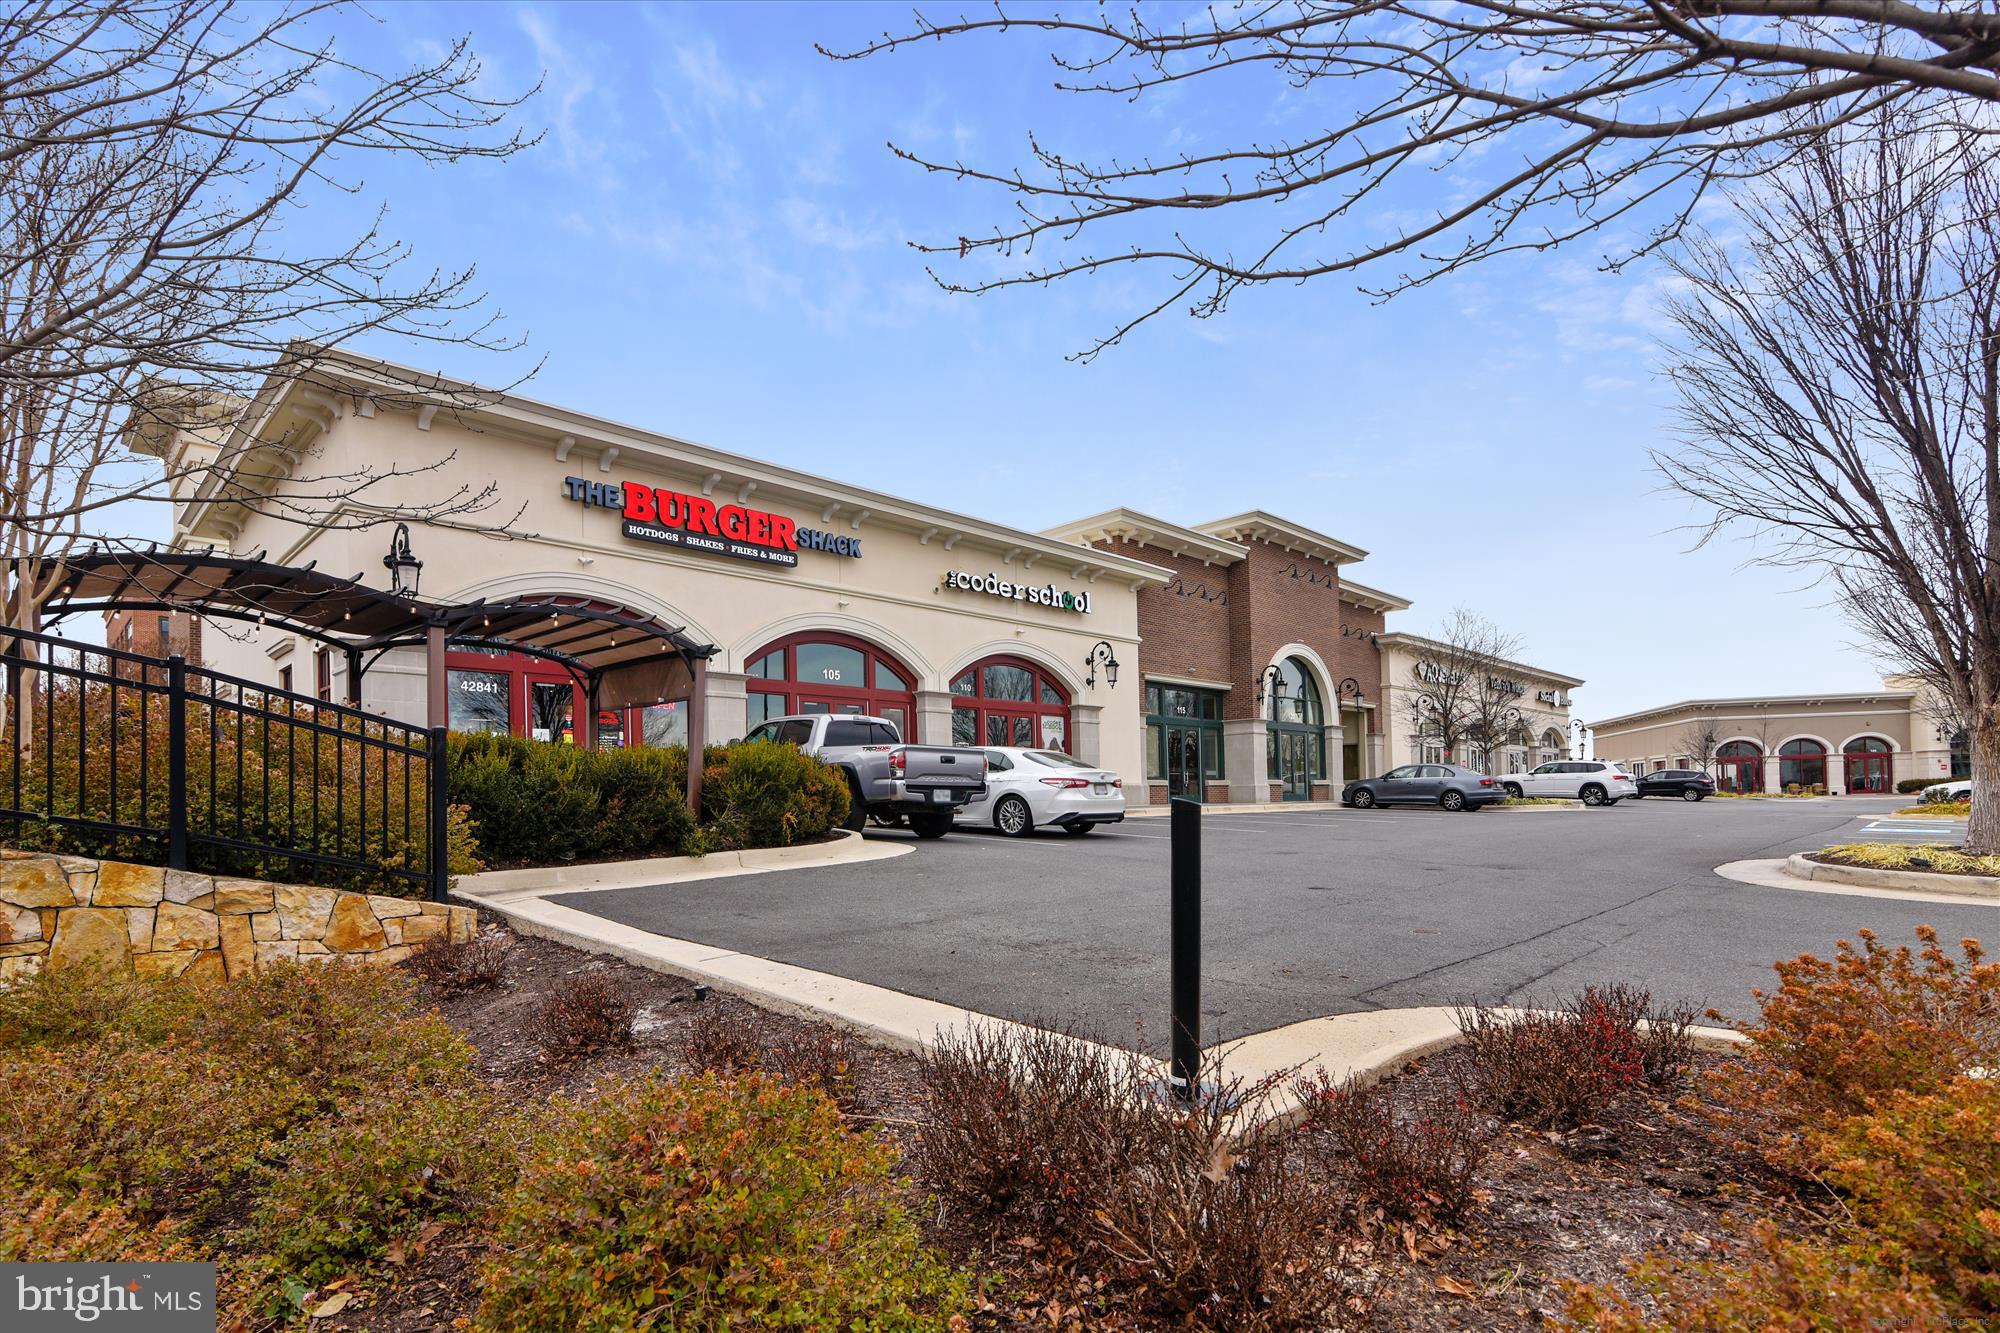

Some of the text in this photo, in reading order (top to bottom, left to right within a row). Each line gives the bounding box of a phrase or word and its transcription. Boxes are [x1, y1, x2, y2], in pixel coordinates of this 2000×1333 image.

[564, 476, 863, 558] THE BURGER SHACK
[628, 524, 795, 564] HOTDOGS SHAKES FRIES & MORE
[822, 668, 841, 681] 105
[460, 680, 499, 694] 42841
[960, 683, 972, 692] 110
